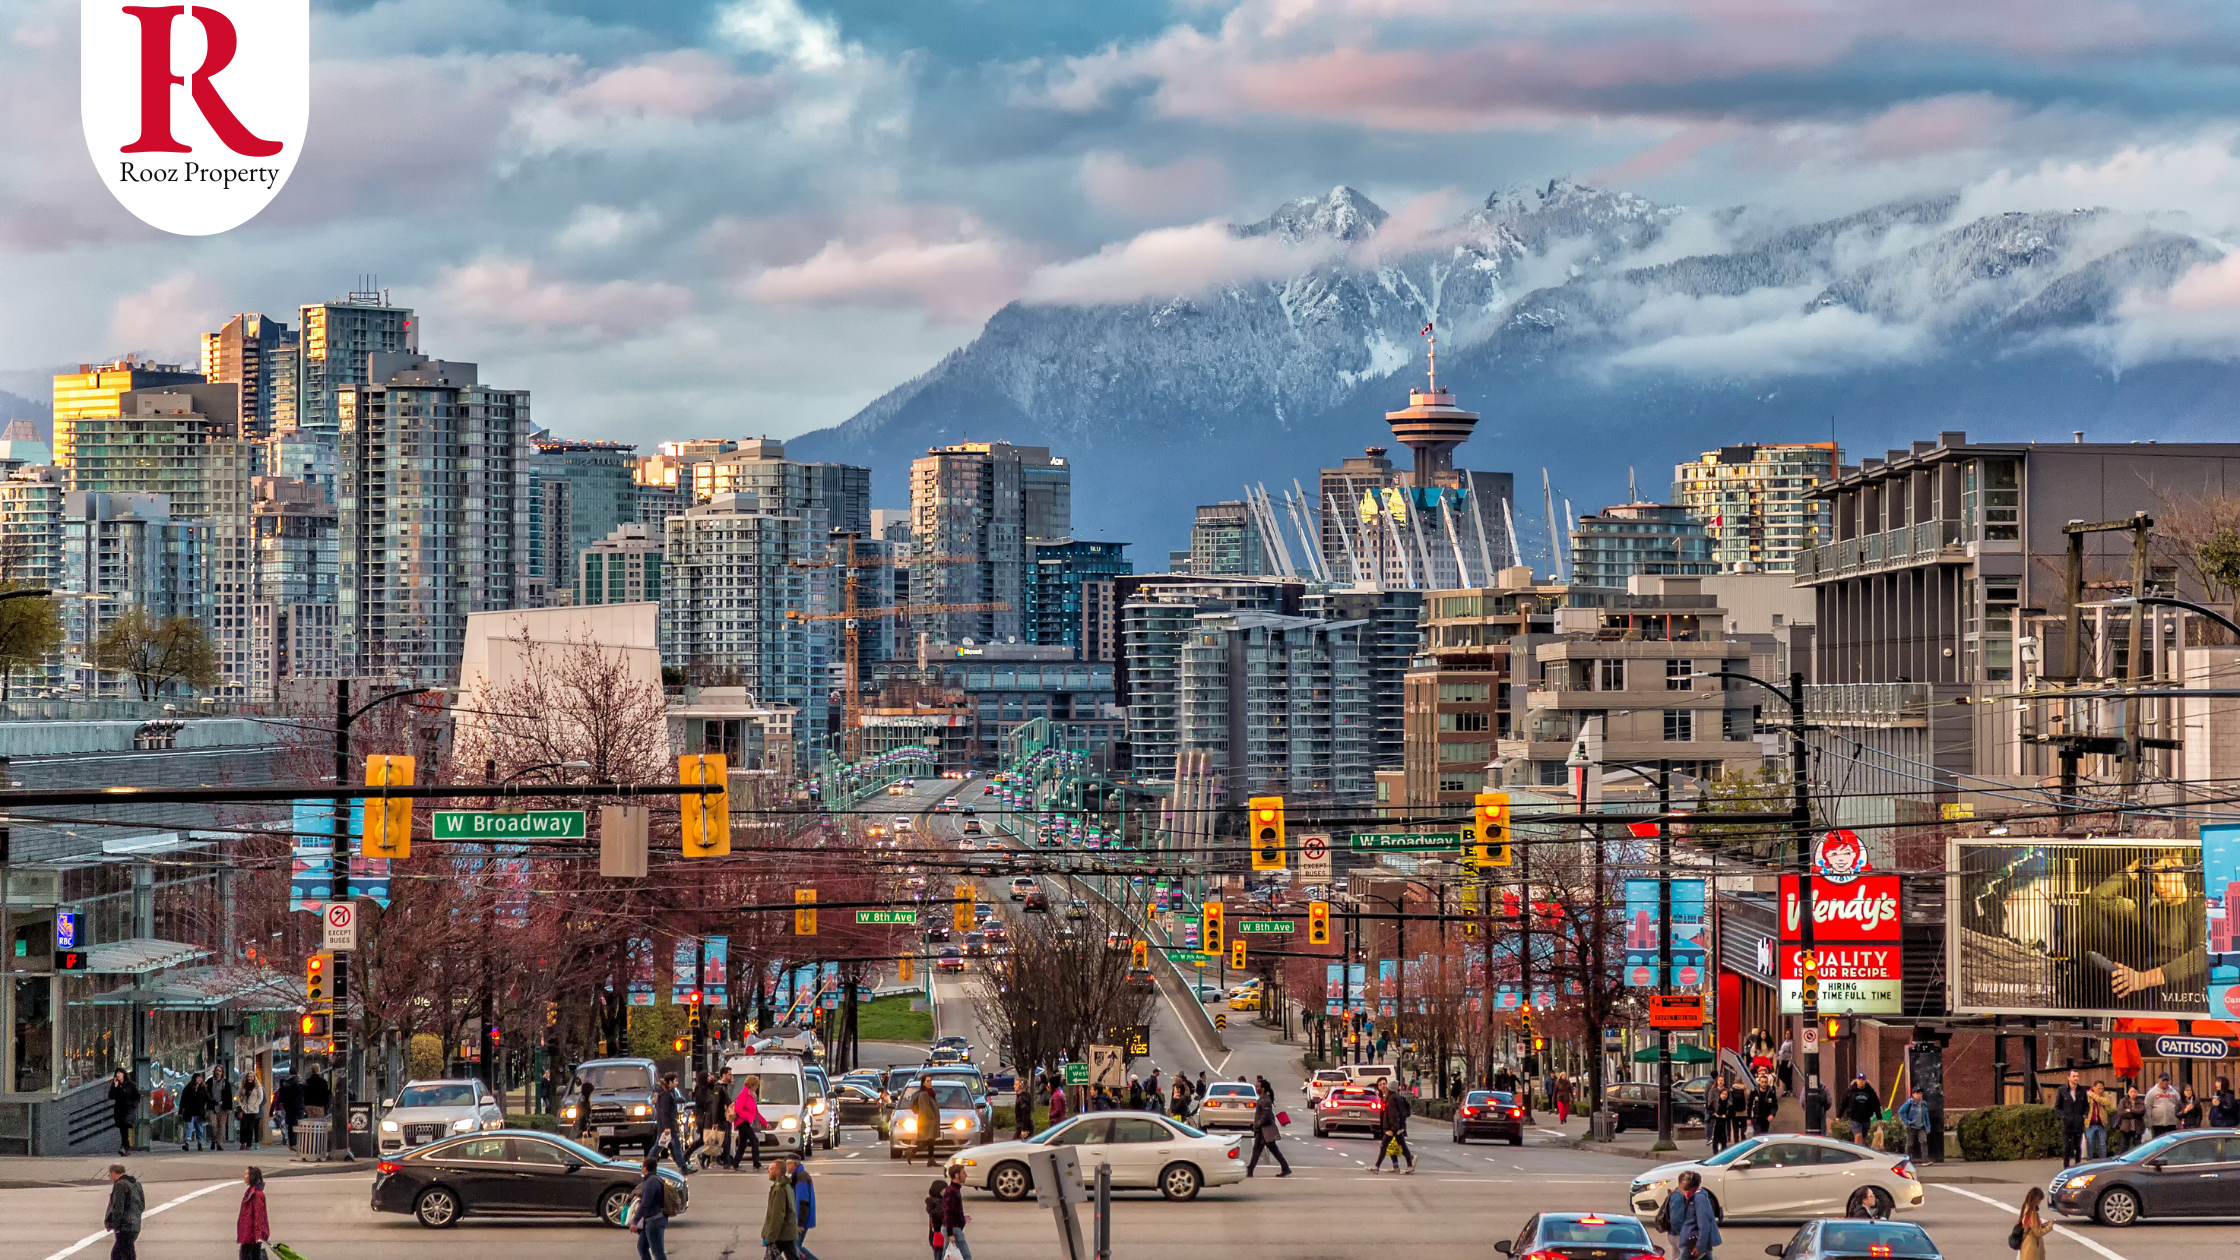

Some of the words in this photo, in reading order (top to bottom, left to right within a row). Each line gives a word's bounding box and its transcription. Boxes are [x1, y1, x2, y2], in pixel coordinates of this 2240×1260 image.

[446, 815, 464, 832] W
[474, 814, 572, 836] Broadway
[1360, 835, 1374, 847] W
[1380, 834, 1454, 850] Broadway
[1303, 862, 1327, 870] EXCEPT
[1787, 884, 1897, 931] Wendy's
[860, 912, 870, 922] W
[873, 912, 890, 922] 8th
[894, 912, 912, 922] Ave
[1243, 923, 1251, 931] W
[1255, 923, 1270, 931] 8th
[1274, 923, 1290, 931] Ave
[58, 937, 72, 946] RBC
[1817, 967, 1838, 978] UR
[1828, 982, 1857, 990] HIRING
[1822, 991, 1843, 1000] TIME
[1844, 991, 1867, 1000] FULL
[1872, 991, 1892, 1000] TIME
[2161, 1040, 2223, 1055] PATTISON
